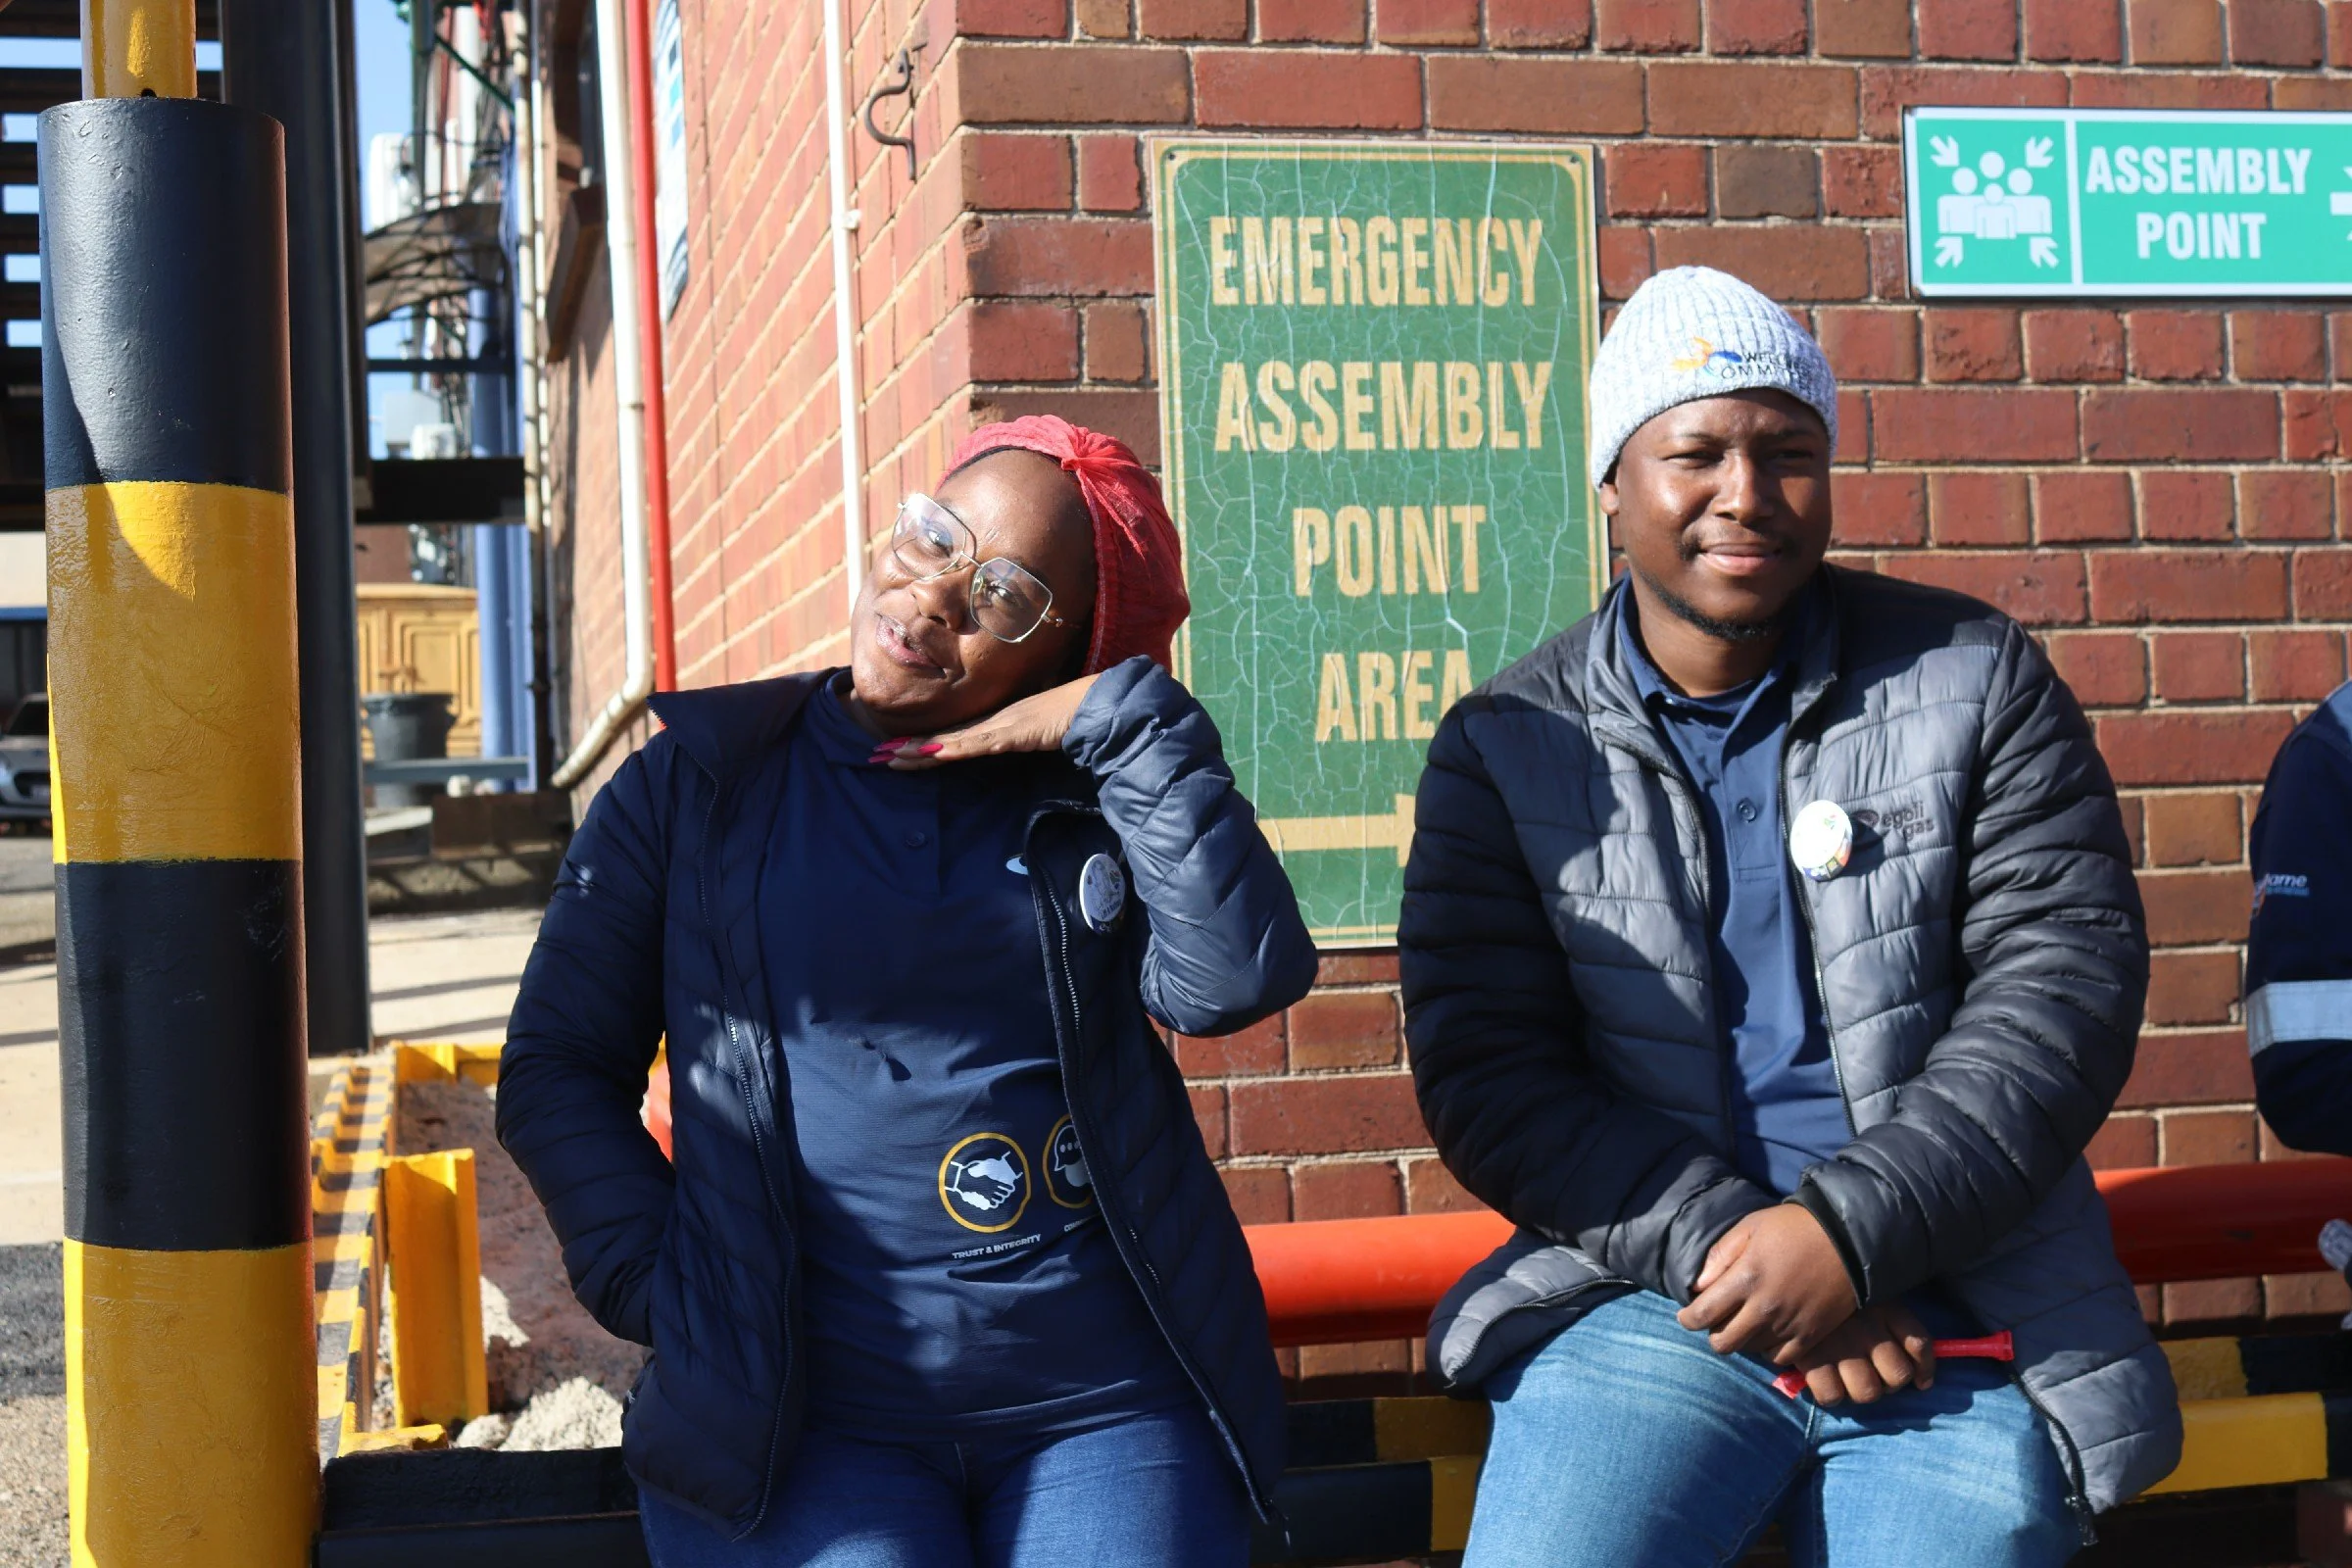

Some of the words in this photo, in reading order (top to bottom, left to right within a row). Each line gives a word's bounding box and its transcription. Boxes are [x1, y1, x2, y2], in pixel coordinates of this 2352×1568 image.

[2085, 146, 2312, 194] ASSEMBLY
[2136, 212, 2267, 260] POINT
[1209, 216, 1543, 308] EMERGENCY
[1215, 361, 1551, 453] ASSEMBLY
[1293, 505, 1486, 597] POINT
[1314, 650, 1473, 742] AREA
[1881, 800, 1924, 830] egoli
[1902, 818, 1935, 841] gas
[952, 1248, 985, 1259] TRUST
[985, 1246, 993, 1254] &
[993, 1234, 1042, 1253] INTEGRITY
